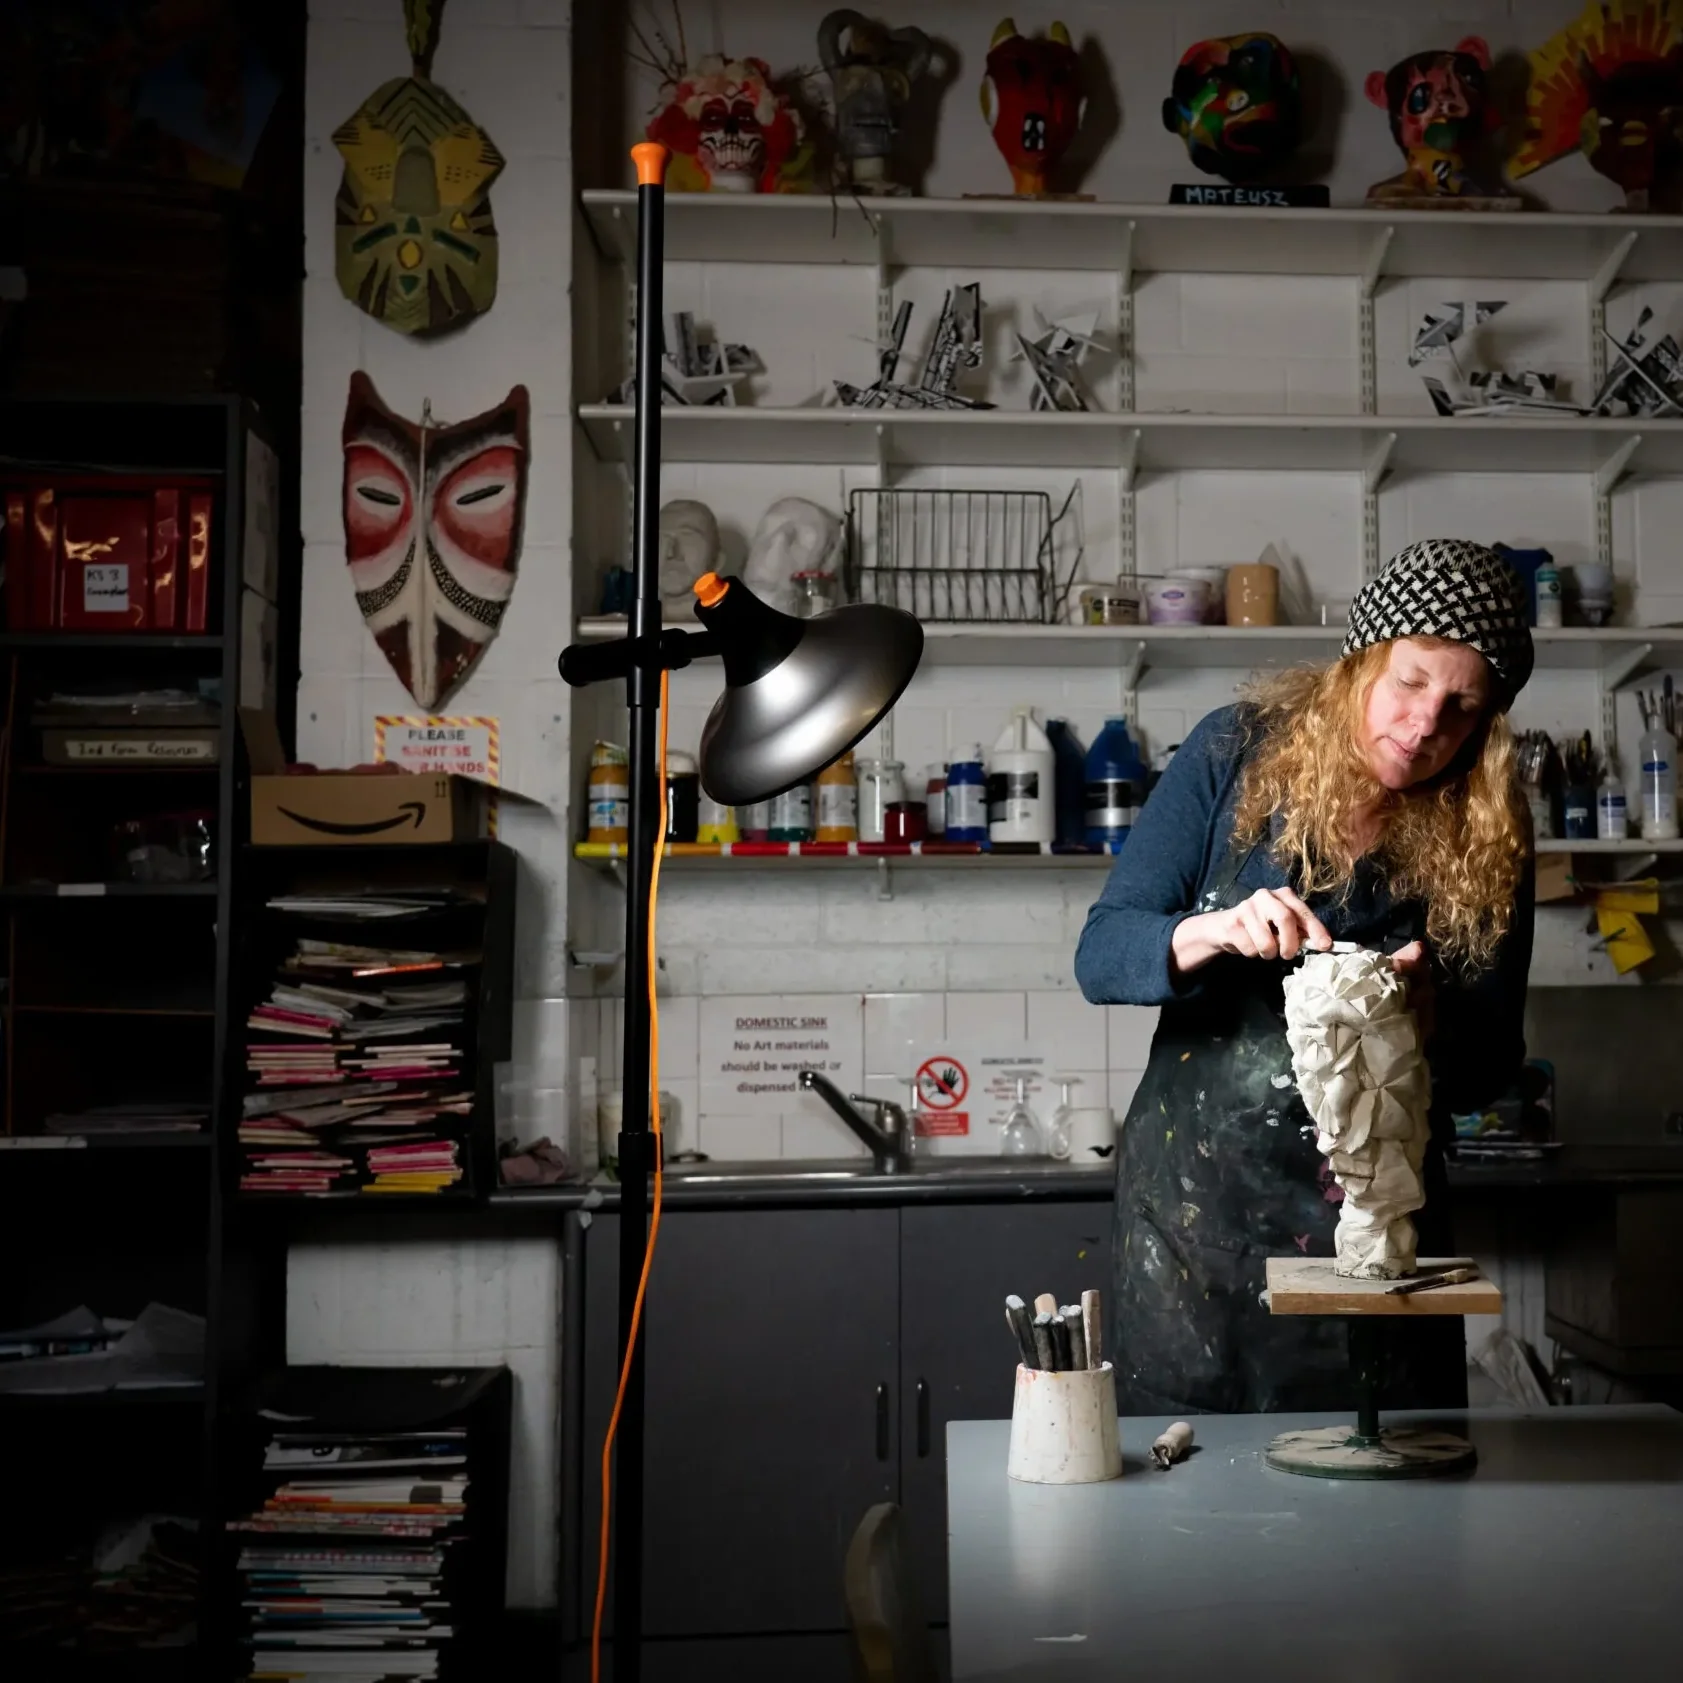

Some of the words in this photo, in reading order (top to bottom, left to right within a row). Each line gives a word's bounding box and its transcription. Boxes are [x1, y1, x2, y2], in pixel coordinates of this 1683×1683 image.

[1185, 186, 1289, 206] MATEUSZ
[408, 729, 465, 741] PLEASE
[402, 745, 471, 757] SANITSE
[735, 1017, 798, 1029] DOMESTIC
[801, 1017, 828, 1029] SINK
[734, 1040, 751, 1051] No
[754, 1040, 772, 1051] Art
[775, 1039, 829, 1051] materials
[721, 1061, 760, 1072] should
[764, 1061, 777, 1072] be
[781, 1060, 826, 1072] washed
[829, 1062, 842, 1071] or
[737, 1082, 796, 1094] dispensed
